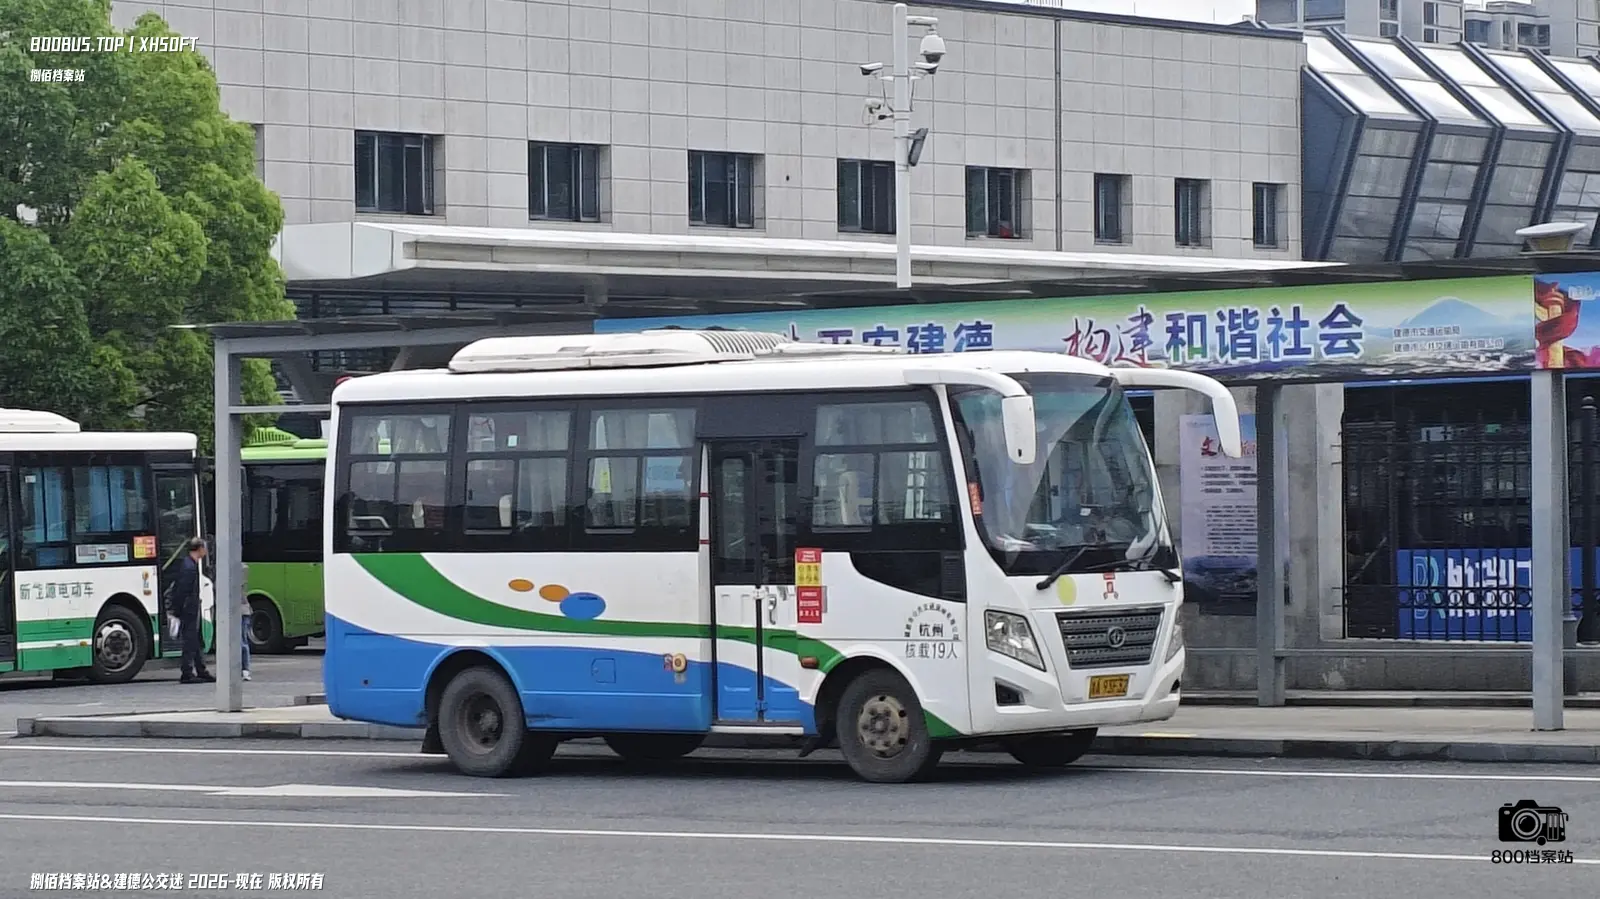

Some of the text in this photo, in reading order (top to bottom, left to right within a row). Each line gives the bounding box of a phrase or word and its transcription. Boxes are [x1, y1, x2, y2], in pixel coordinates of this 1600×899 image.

[919, 623, 944, 638] 杭州
[905, 642, 958, 660] 核载19人
